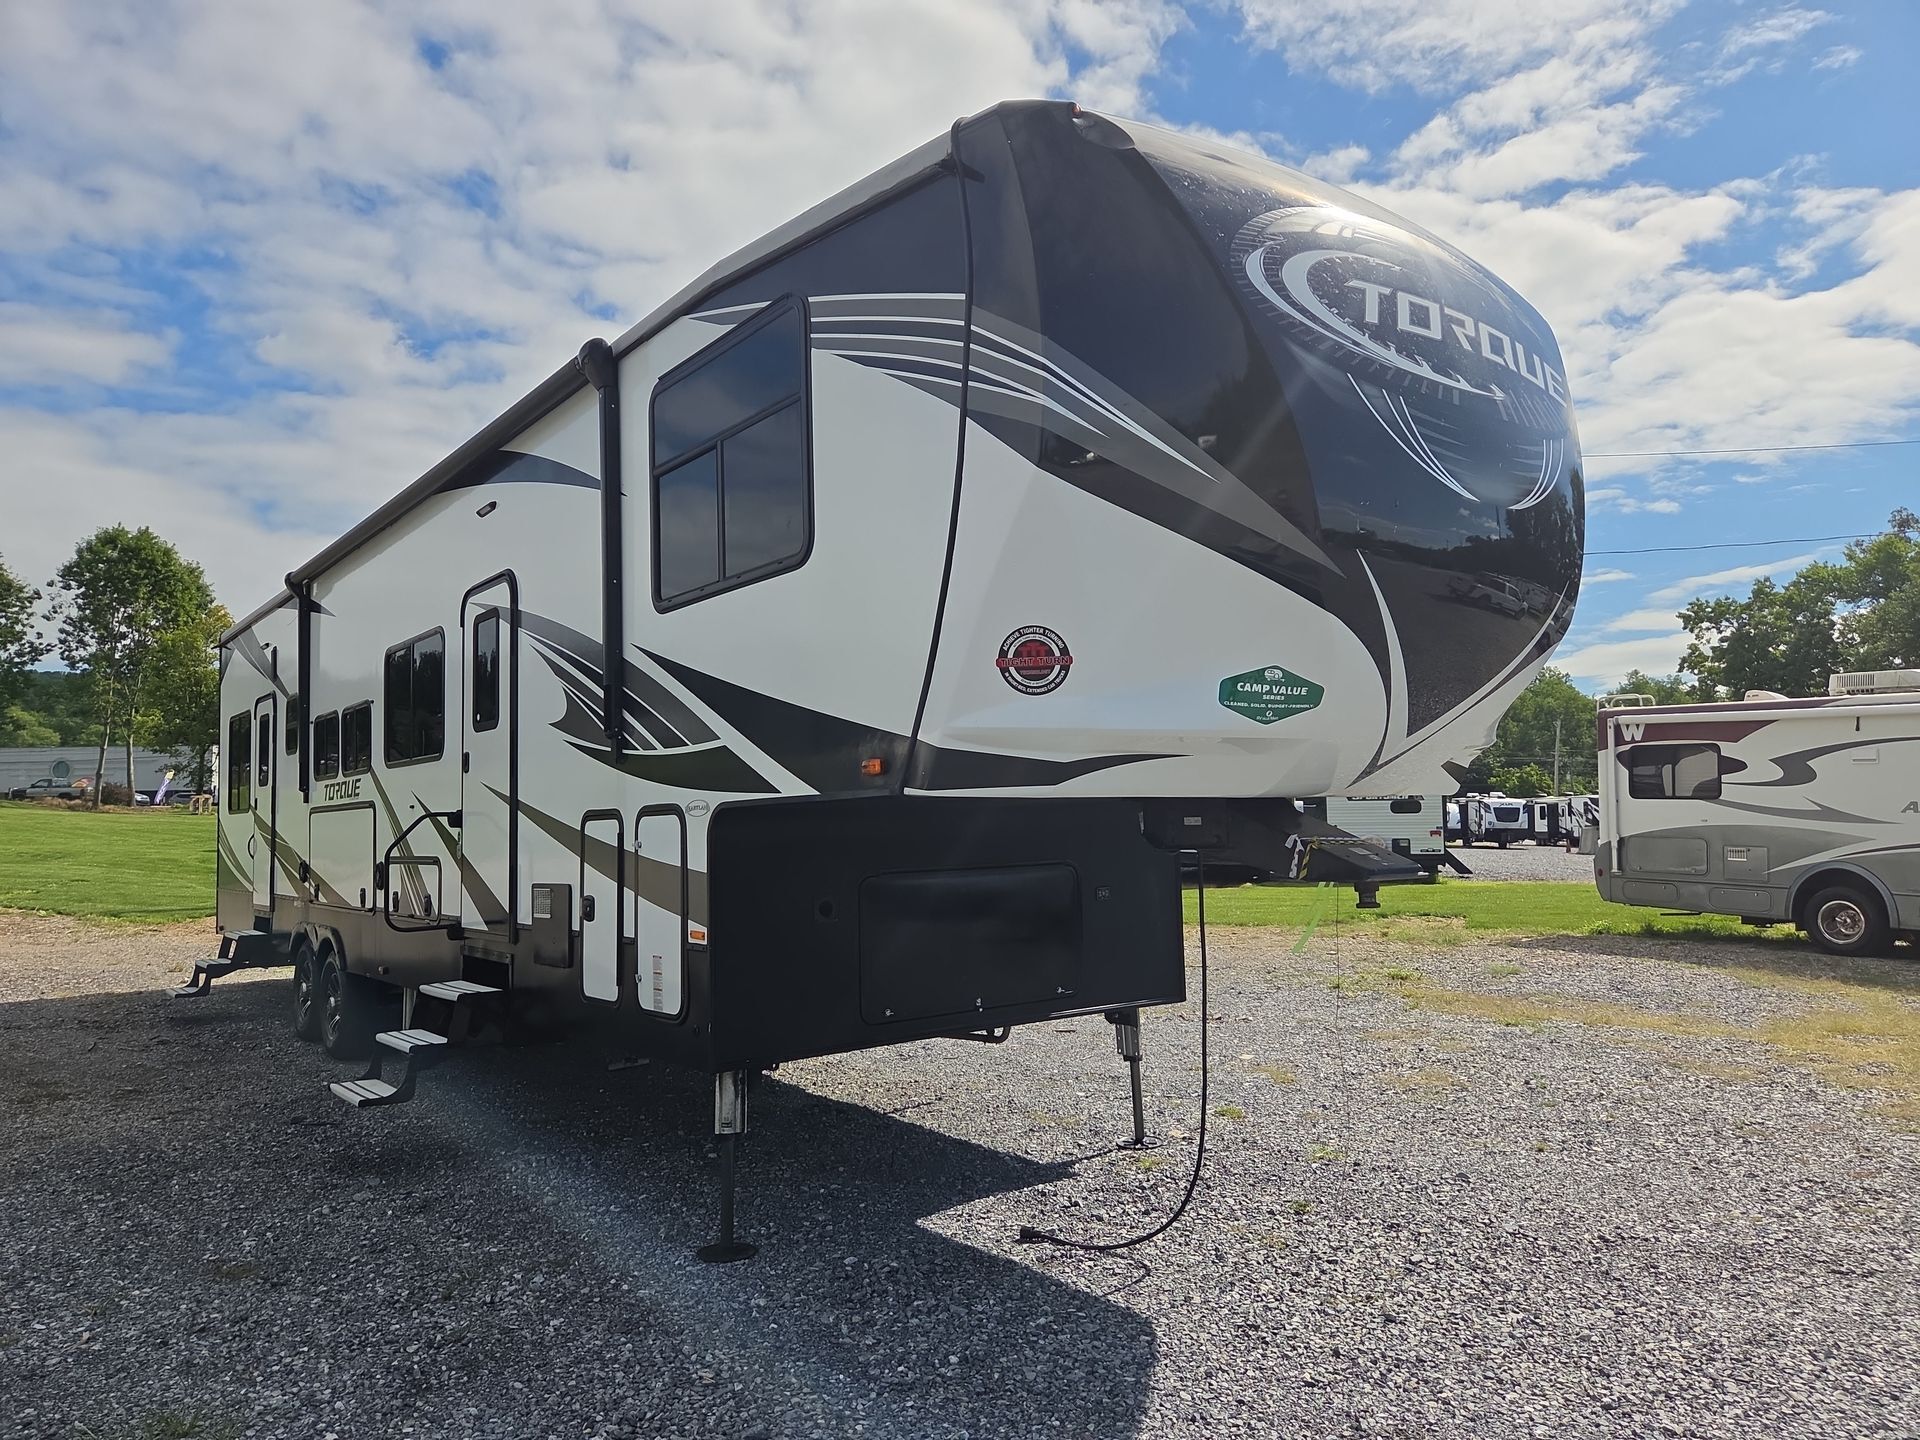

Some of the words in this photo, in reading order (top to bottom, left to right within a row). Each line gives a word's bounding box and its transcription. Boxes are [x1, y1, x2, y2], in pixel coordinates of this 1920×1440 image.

[1344, 279, 1567, 409] TORQUE
[1000, 658, 1034, 667] TIGHT
[1037, 656, 1070, 665] TURN
[1236, 682, 1270, 694] CAMP
[1272, 685, 1309, 696] VALUE
[1620, 723, 1646, 742] W
[324, 778, 362, 802] TORQUE
